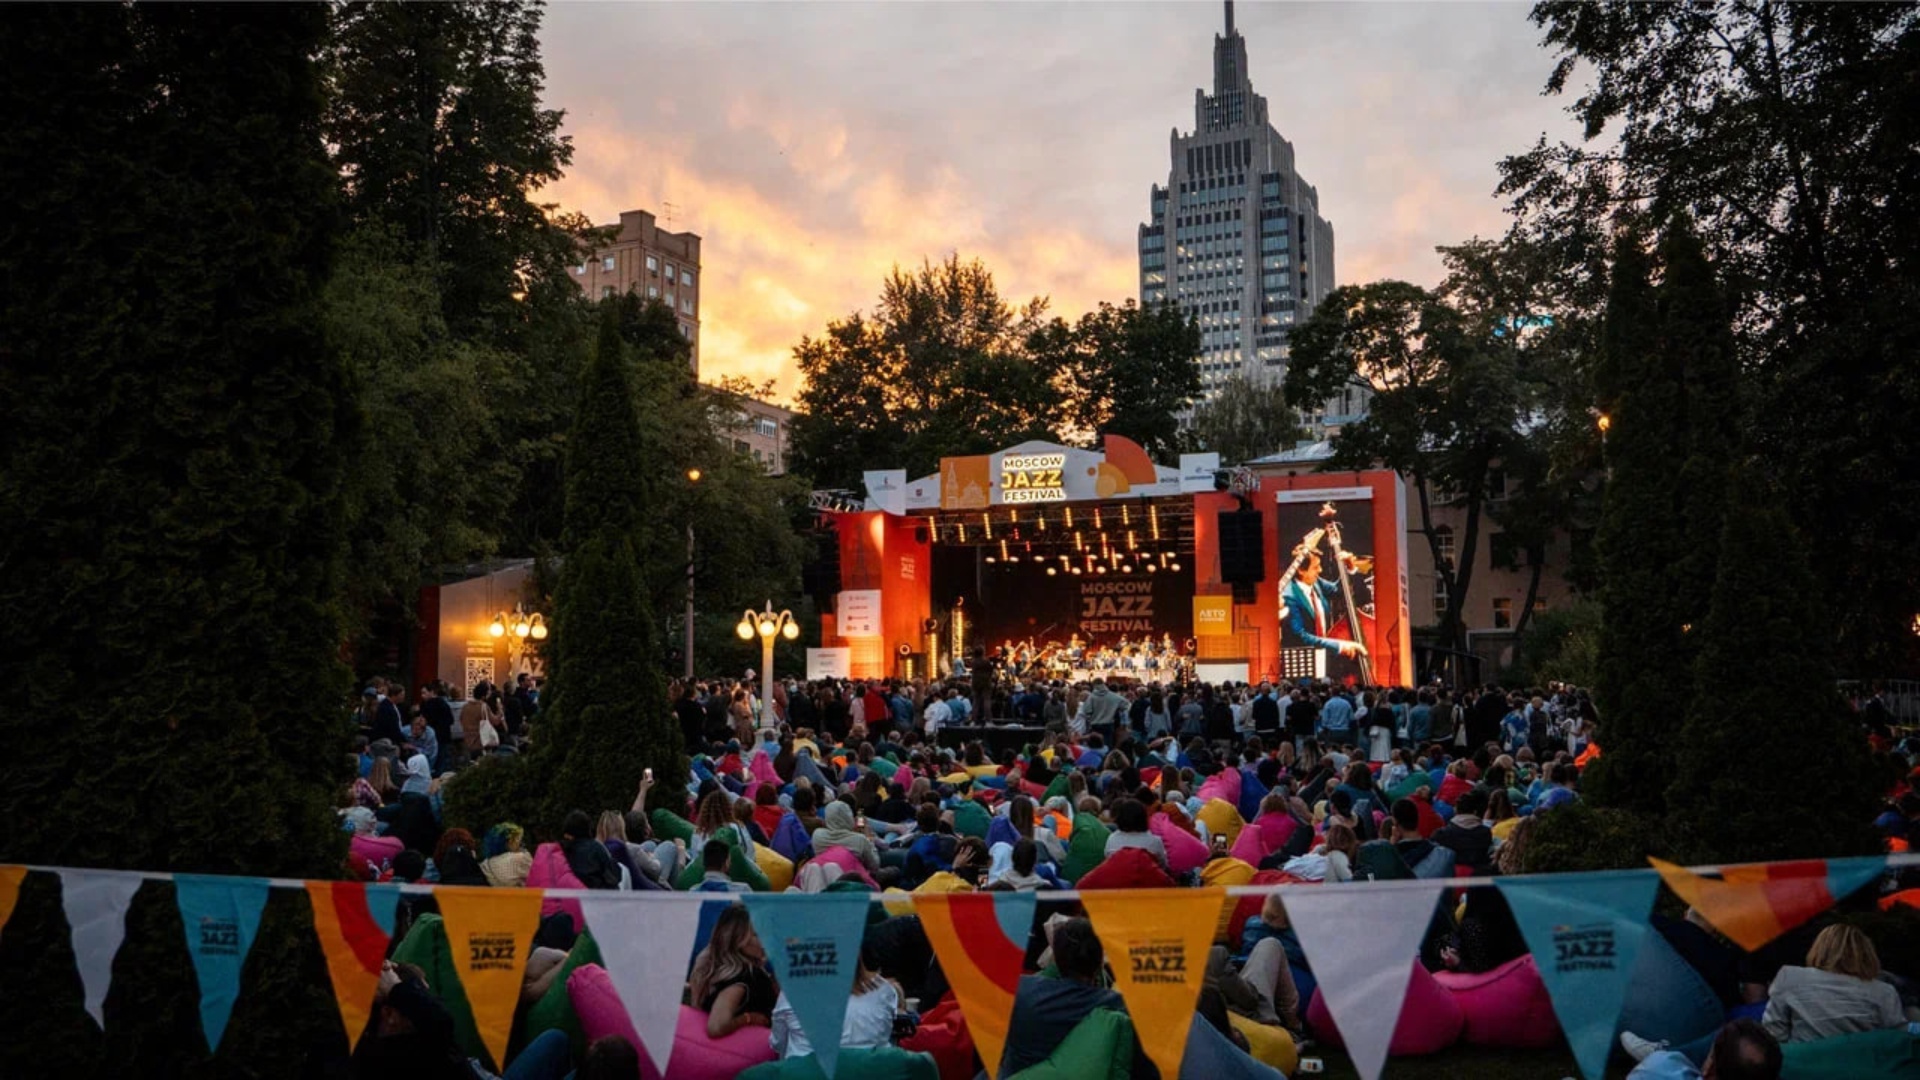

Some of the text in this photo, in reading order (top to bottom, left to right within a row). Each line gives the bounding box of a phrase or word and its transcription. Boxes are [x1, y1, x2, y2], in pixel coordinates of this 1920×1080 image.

[1003, 456, 1063, 469] MOSCOW
[1000, 469, 1063, 489] JAZZ
[1003, 489, 1064, 502] FESTIVAL
[1081, 581, 1153, 595] MOSCOW
[1082, 596, 1154, 617] JAZZ
[1080, 619, 1154, 632] FESTIVAL
[469, 938, 516, 946] MOSCOW
[1553, 930, 1614, 942] MOSCOW
[470, 945, 517, 961] JAZZ
[786, 943, 837, 952] MOSCOW
[1129, 946, 1184, 955] MOSCOW
[1555, 940, 1617, 960] JAZZ
[788, 951, 839, 967] JAZZ
[1131, 956, 1187, 972] JAZZ
[470, 962, 515, 971] FESTIVAL
[788, 968, 840, 978] FESTIVAL
[1556, 960, 1617, 973] FESTIVAL
[1132, 974, 1187, 984] FESTIVAL
